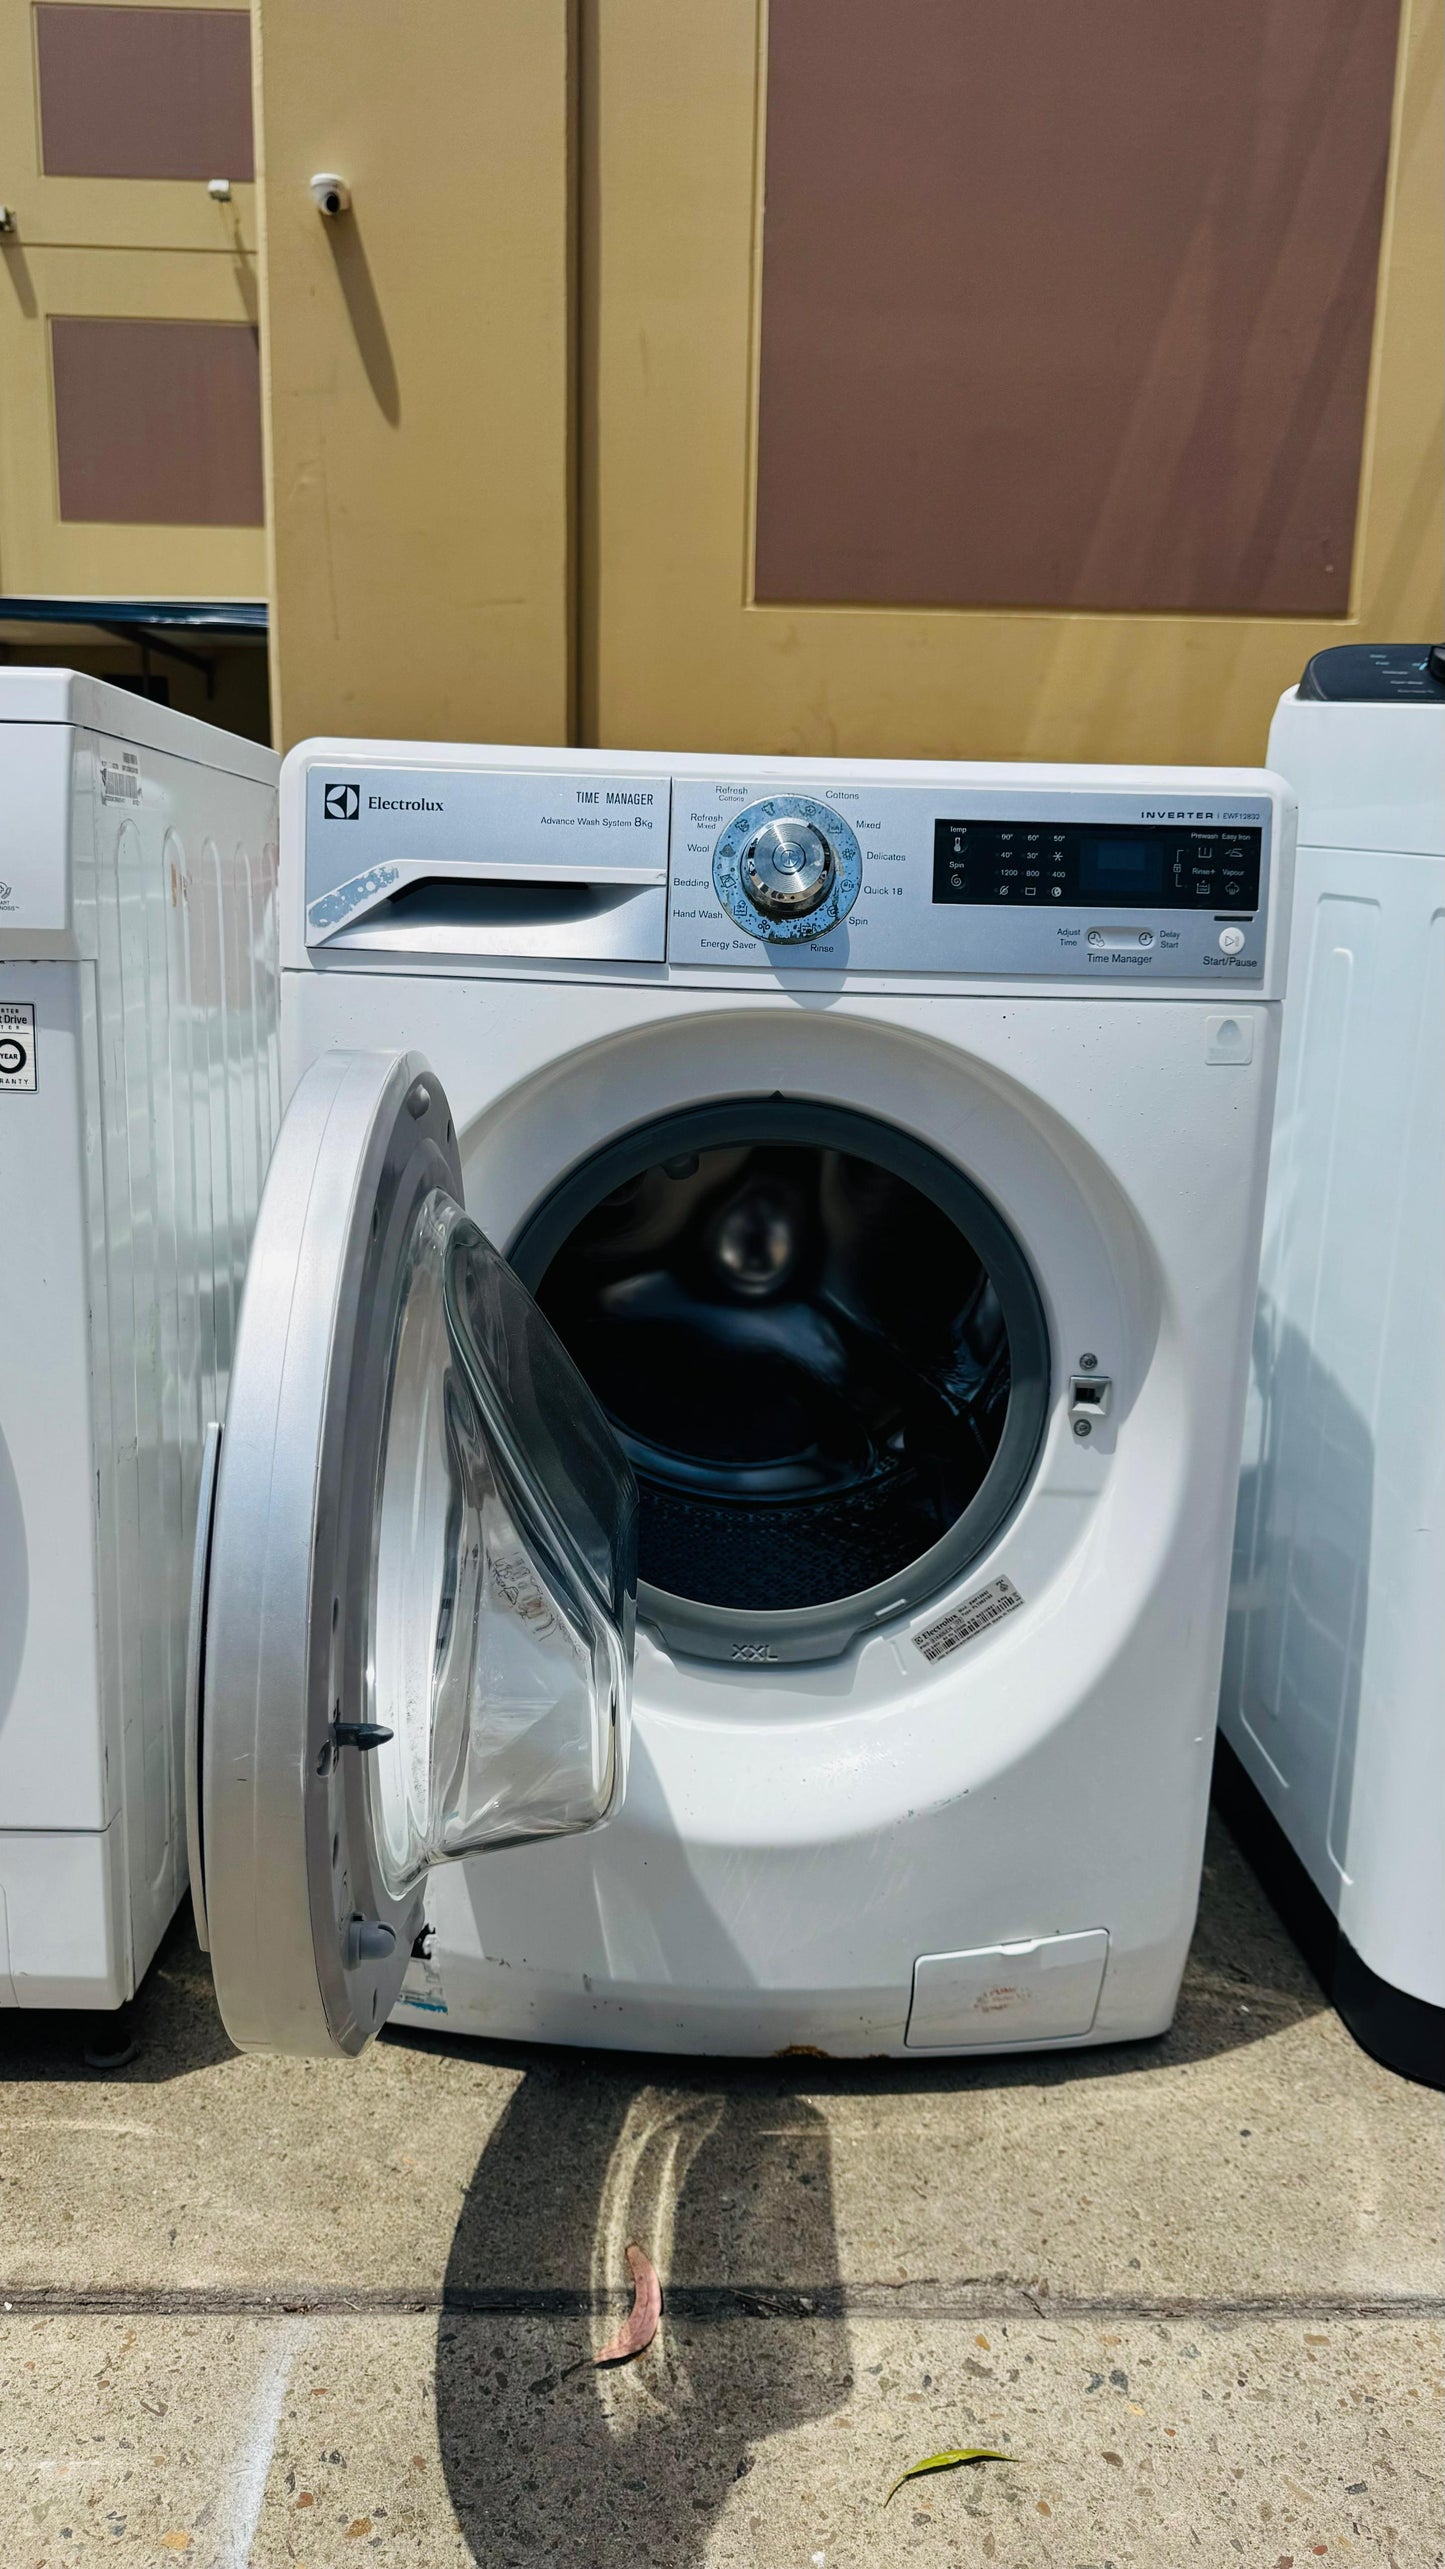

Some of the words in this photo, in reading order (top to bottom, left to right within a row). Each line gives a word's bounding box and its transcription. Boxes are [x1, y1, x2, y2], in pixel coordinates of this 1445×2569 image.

[715, 785, 749, 795] Refresh
[576, 791, 600, 804] TIME
[606, 792, 654, 806] MANAGER
[718, 794, 745, 802] Cottons
[825, 790, 860, 801] Cottons
[368, 796, 444, 812] Electrolux
[690, 813, 724, 823] Refresh
[1141, 811, 1214, 819] INVERTER
[540, 816, 575, 826] Advance
[577, 817, 601, 827] Wash
[602, 817, 632, 829] System
[634, 816, 653, 829] 8Kg
[696, 822, 717, 830] Mixed
[856, 820, 881, 830] Mixed
[950, 826, 967, 834] Temp
[1222, 833, 1238, 842] Easy
[687, 843, 710, 853] Wool
[866, 851, 907, 862] Delicates
[949, 861, 965, 869] Spin
[673, 878, 710, 890] Bedding
[863, 886, 889, 896] Quick
[891, 887, 903, 895] 18
[673, 909, 696, 919] Hand
[698, 910, 724, 920] Wash
[848, 916, 869, 926] Spin
[1056, 928, 1081, 937] Adjust
[1159, 930, 1180, 940] Delay
[700, 939, 730, 951] Energy
[732, 940, 757, 950] Saver
[810, 943, 835, 953] Rinse
[1059, 939, 1078, 947] Time
[1160, 941, 1179, 949] Start
[1087, 953, 1110, 963] Time
[1111, 954, 1153, 966] Manager
[1202, 956, 1258, 968] Start/Pause
[4, 1015, 28, 1025] Drive
[922, 1614, 958, 1640] Electrolux
[731, 1643, 778, 1661] XXL
